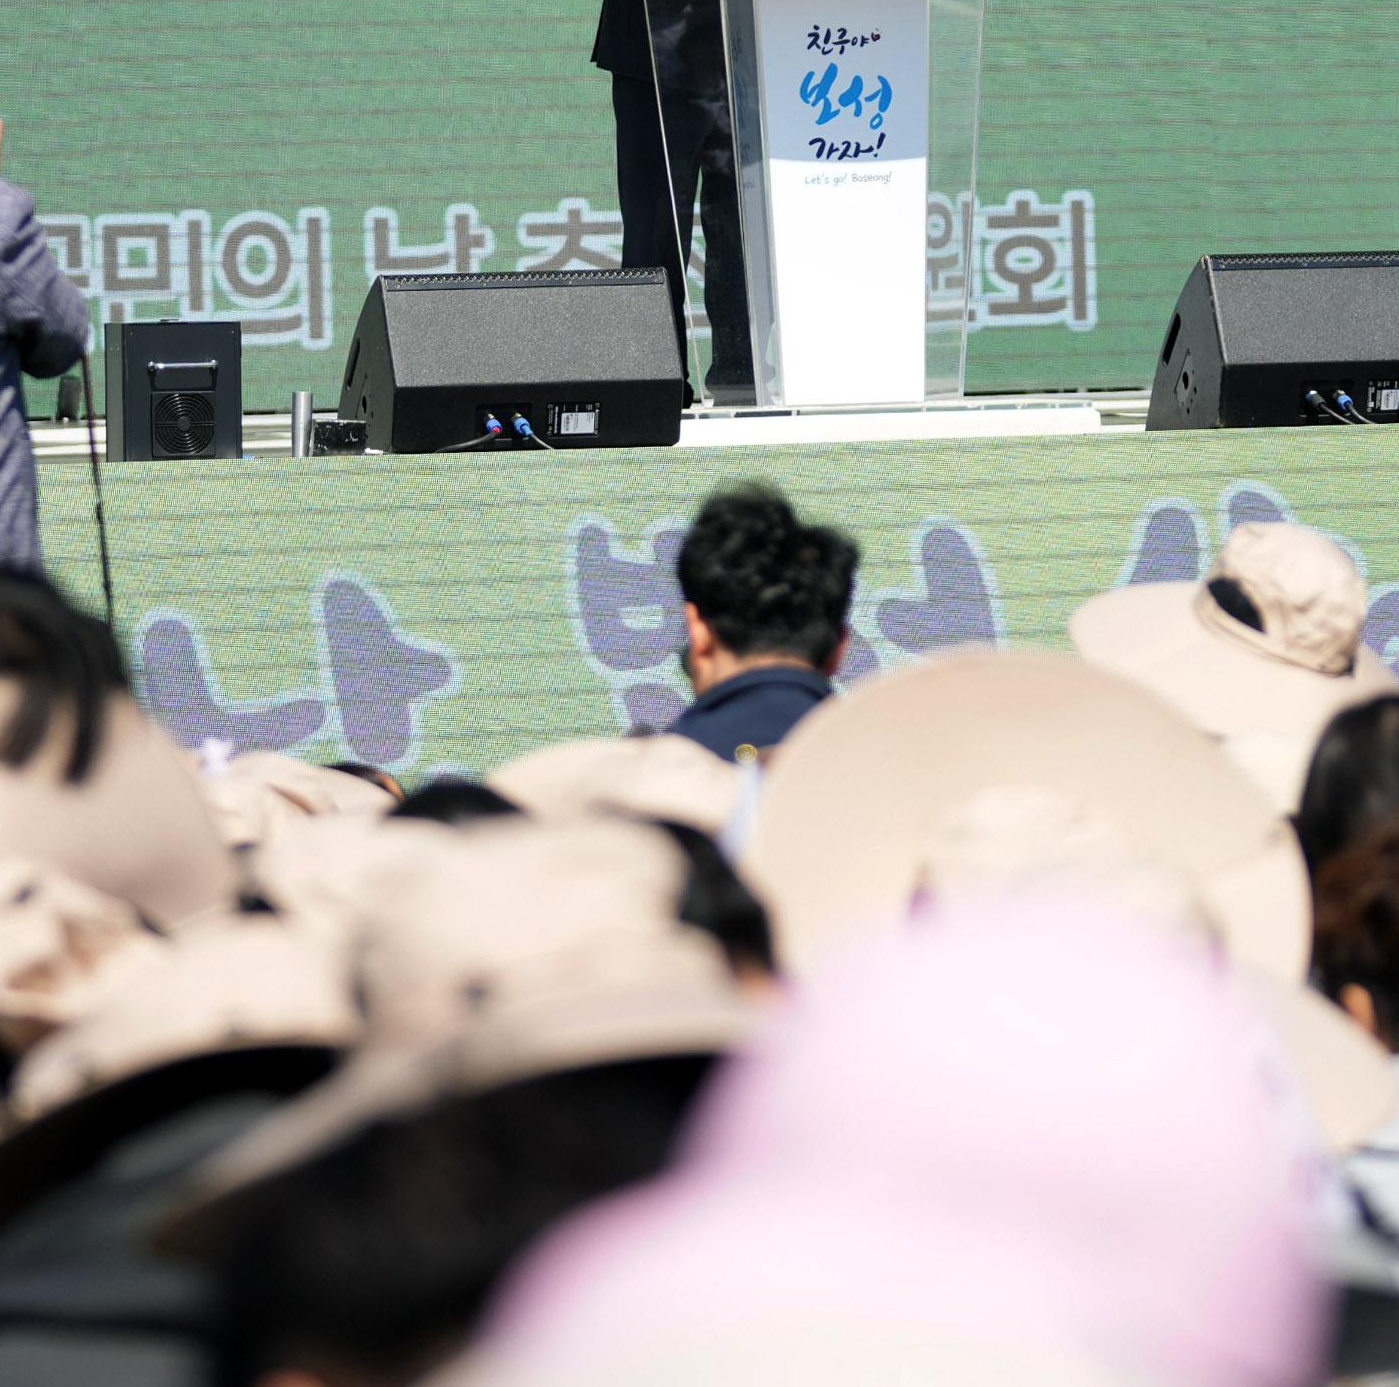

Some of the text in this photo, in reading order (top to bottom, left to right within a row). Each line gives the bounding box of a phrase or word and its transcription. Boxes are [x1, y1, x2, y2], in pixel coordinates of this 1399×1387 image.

[806, 24, 870, 55] 친구야
[799, 62, 893, 130] 보성
[808, 131, 887, 161] 가자!
[804, 171, 892, 186] Let's go! Boseong!
